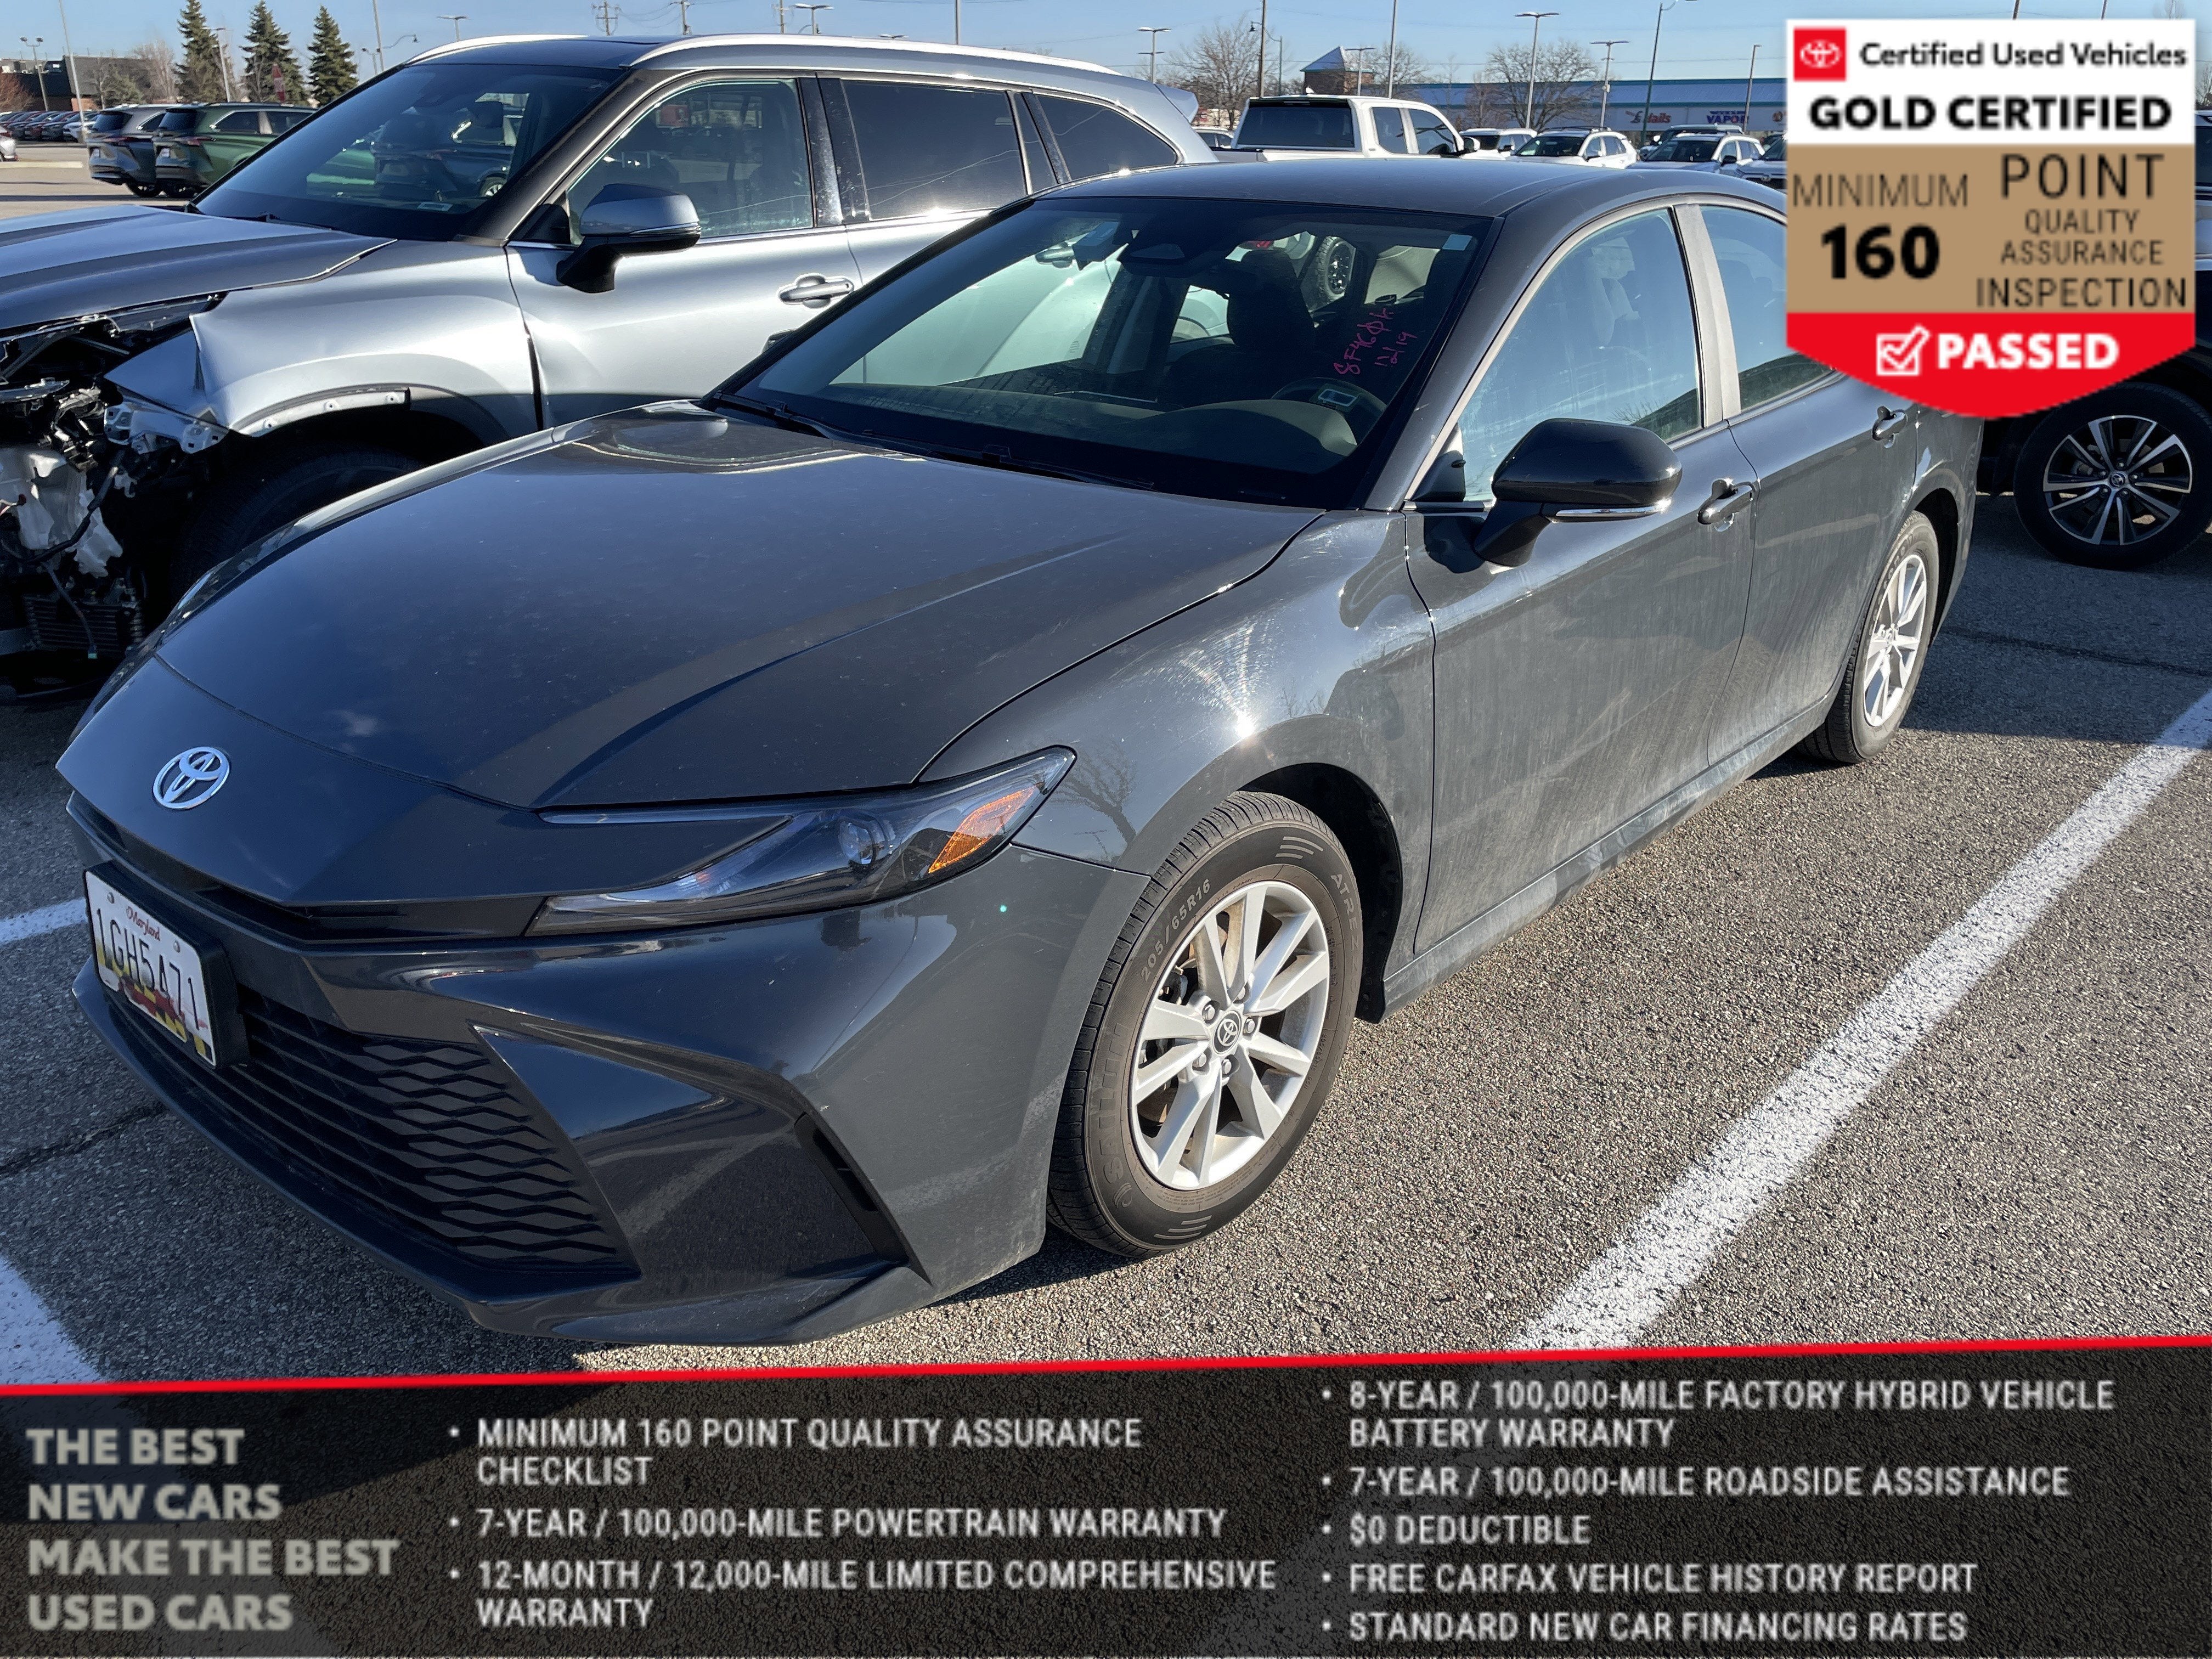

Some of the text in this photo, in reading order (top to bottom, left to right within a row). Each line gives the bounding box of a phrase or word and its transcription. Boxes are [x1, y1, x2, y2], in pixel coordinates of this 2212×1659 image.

[97, 908, 200, 1030] 1GH5471
[126, 906, 161, 942] Maryland
[1141, 879, 1211, 983] 205/65R16
